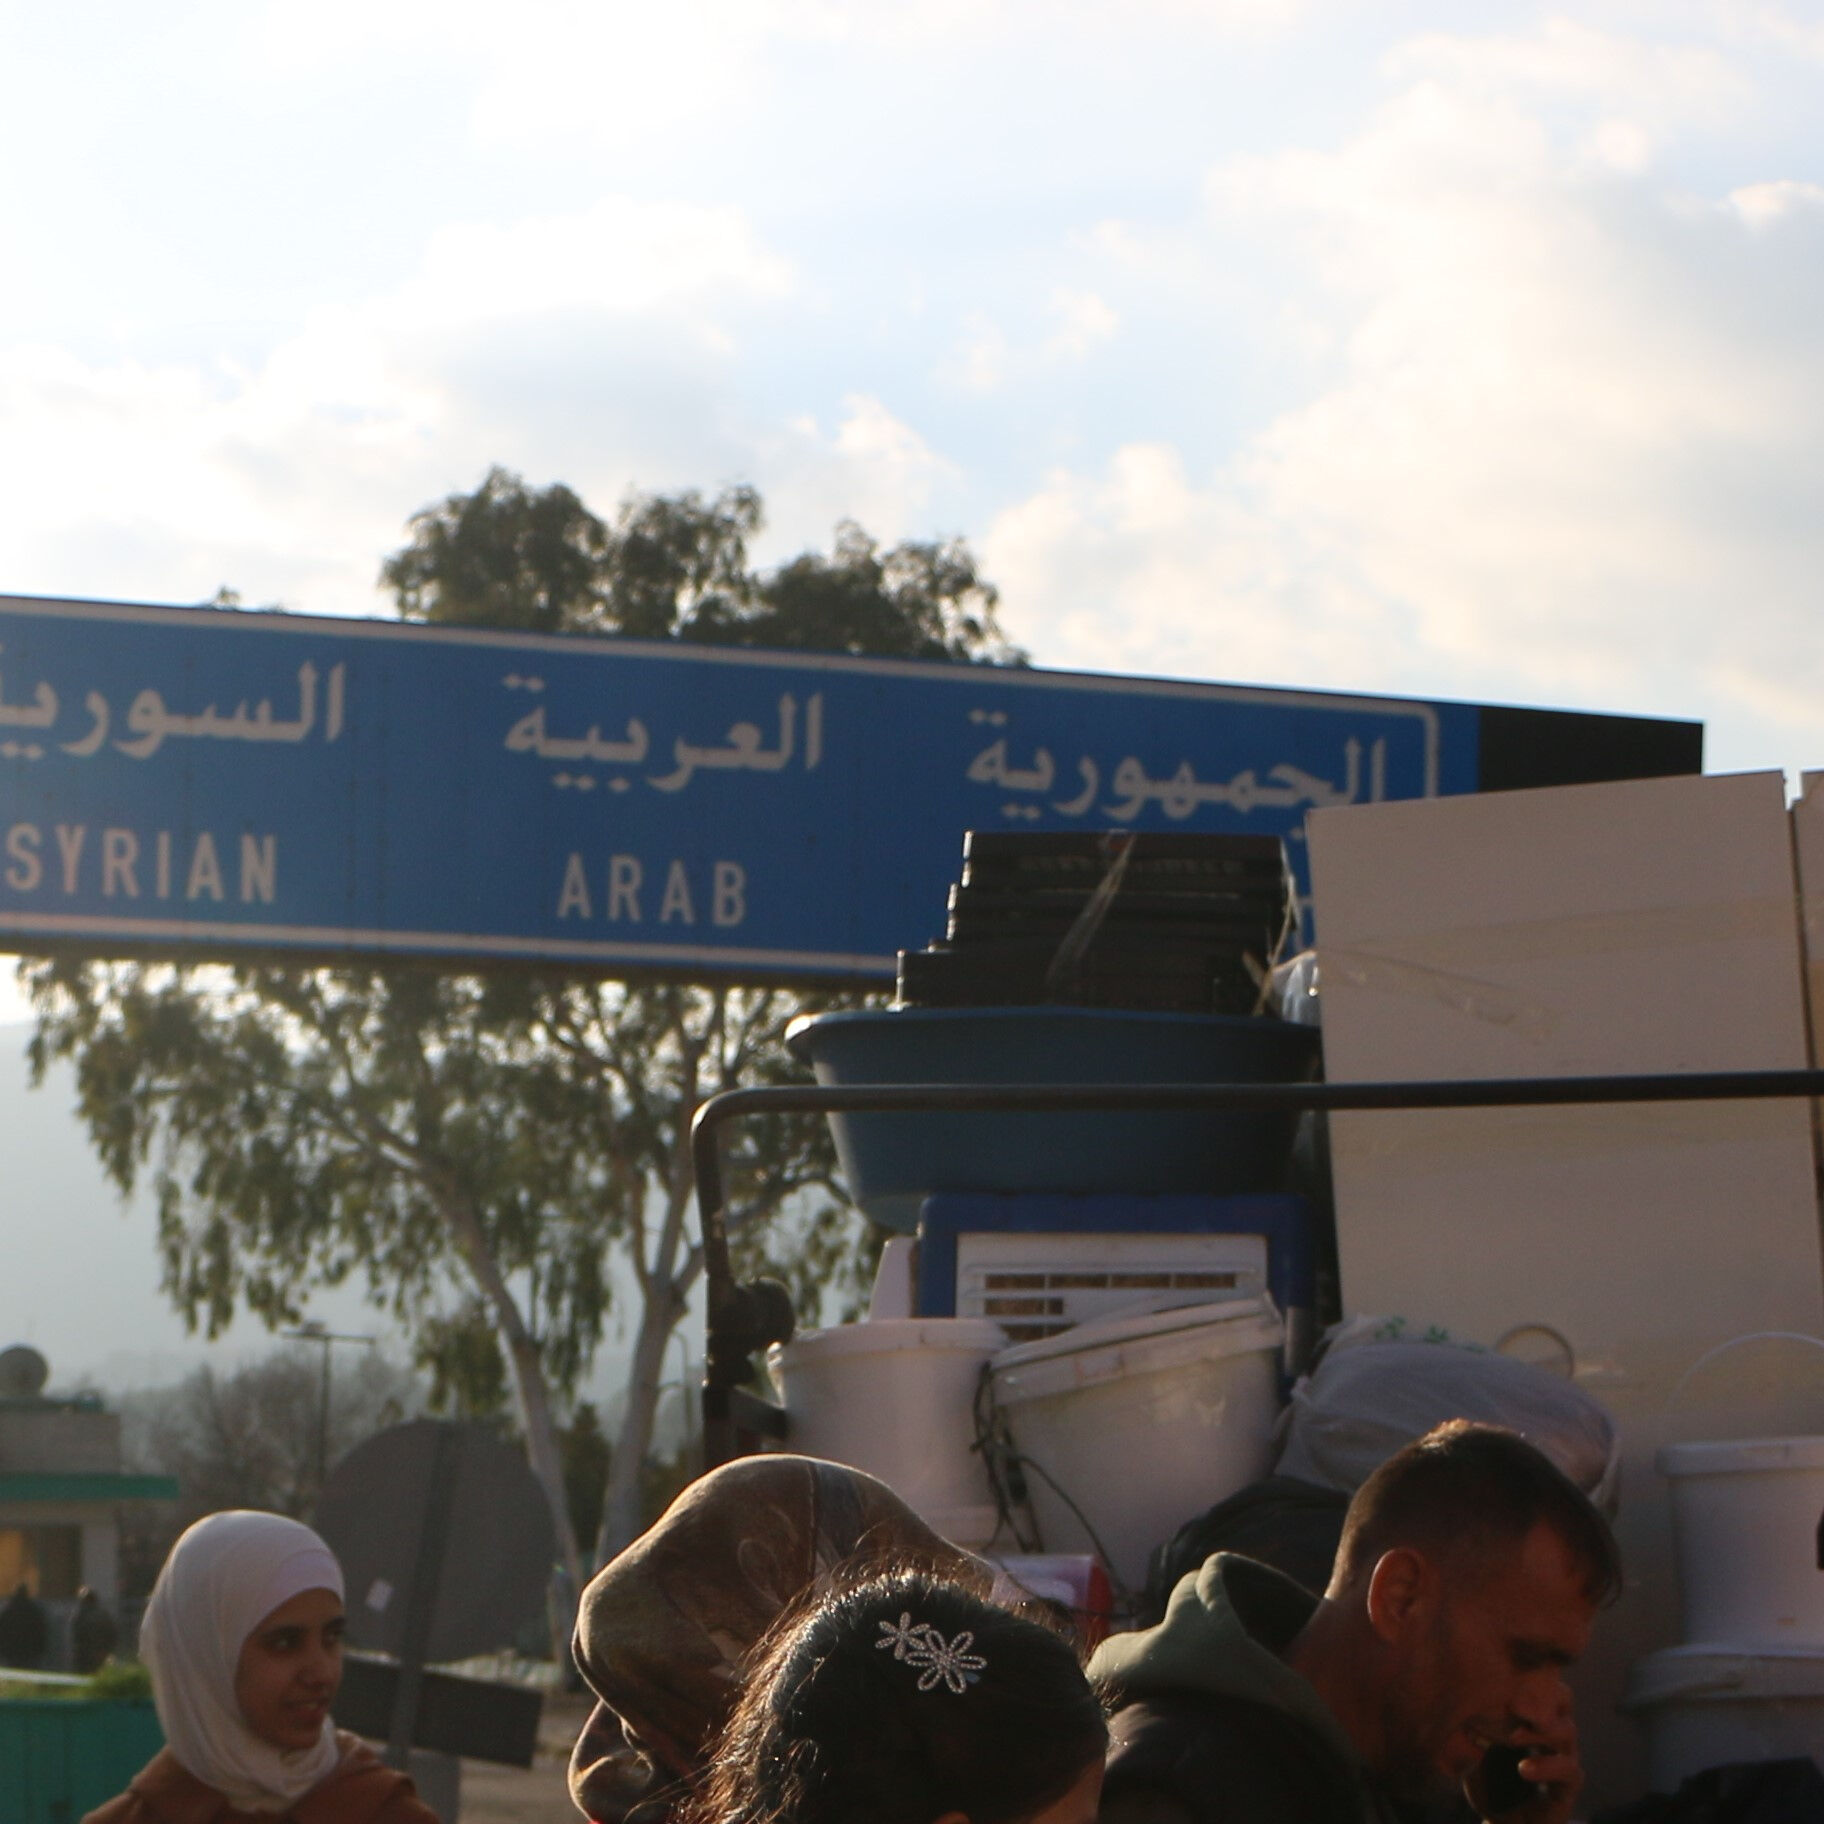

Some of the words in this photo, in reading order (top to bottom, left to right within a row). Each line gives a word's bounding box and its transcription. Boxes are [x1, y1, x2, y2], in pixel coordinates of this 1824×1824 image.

[503, 672, 825, 792] العربية
[966, 708, 1388, 841] الجمهورية
[3, 823, 278, 906] SYRIAN
[556, 853, 748, 928] ARAB
